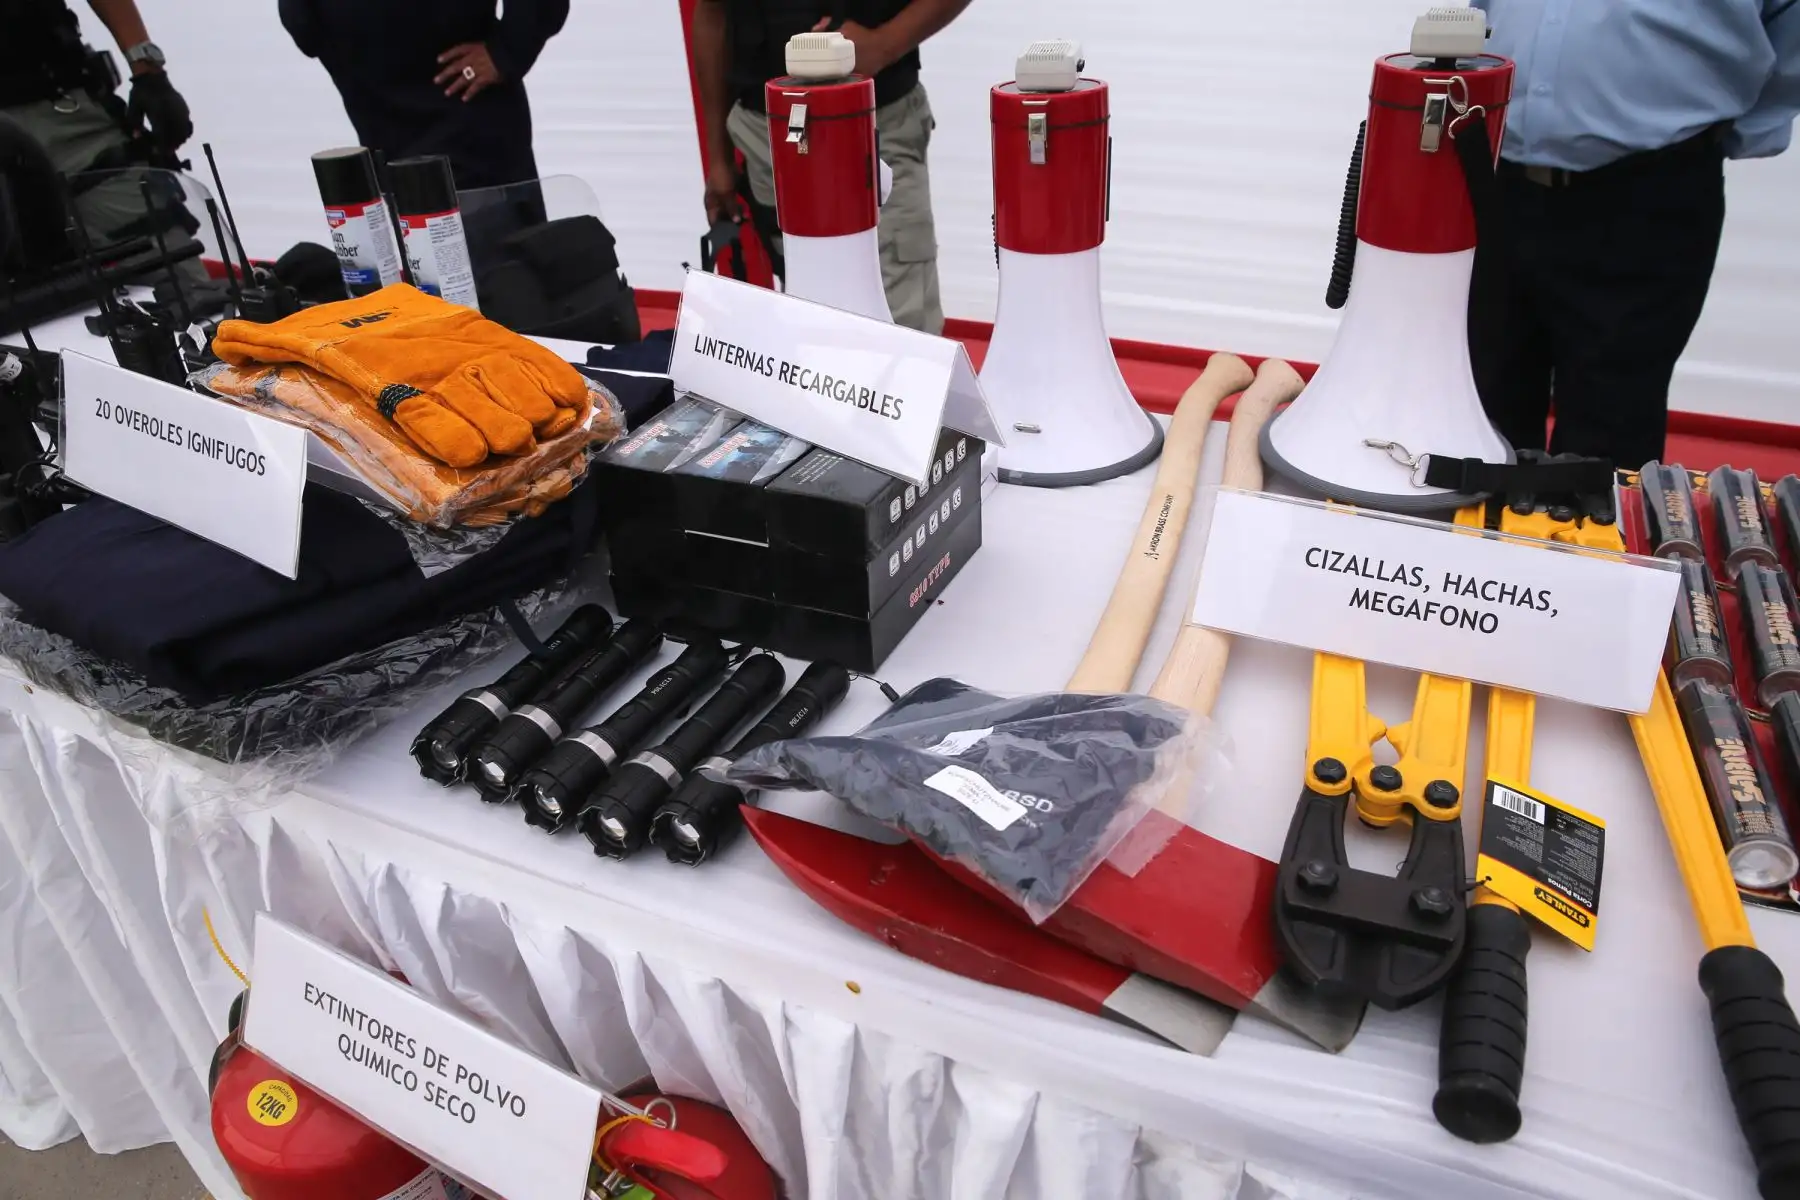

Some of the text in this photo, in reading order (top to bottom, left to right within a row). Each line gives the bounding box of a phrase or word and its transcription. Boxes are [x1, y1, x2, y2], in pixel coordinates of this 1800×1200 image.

[694, 333, 904, 421] LINTERNAS RECARGABLES
[95, 398, 266, 476] 20 OVEROLES IGNIFUGOS
[1149, 494, 1174, 552] AKRON BRASS COMPANY
[928, 551, 951, 586] TYPE
[1305, 547, 1559, 618] CIZALLAS, HACHAS,
[1349, 587, 1499, 634] MEGAFONO
[547, 639, 562, 651] ICIA
[650, 676, 673, 696] POLICIA
[788, 706, 809, 728] POLICIA
[1715, 737, 1767, 806] SABRE
[1538, 891, 1587, 925] STANLEY
[1547, 877, 1593, 908] Corta Pernos
[304, 982, 526, 1117] EXTINTORES DE POLVO
[268, 1083, 293, 1103] CAPACIDAD
[338, 1033, 476, 1124] QUIMICO SECO
[255, 1092, 286, 1120] 12KG
